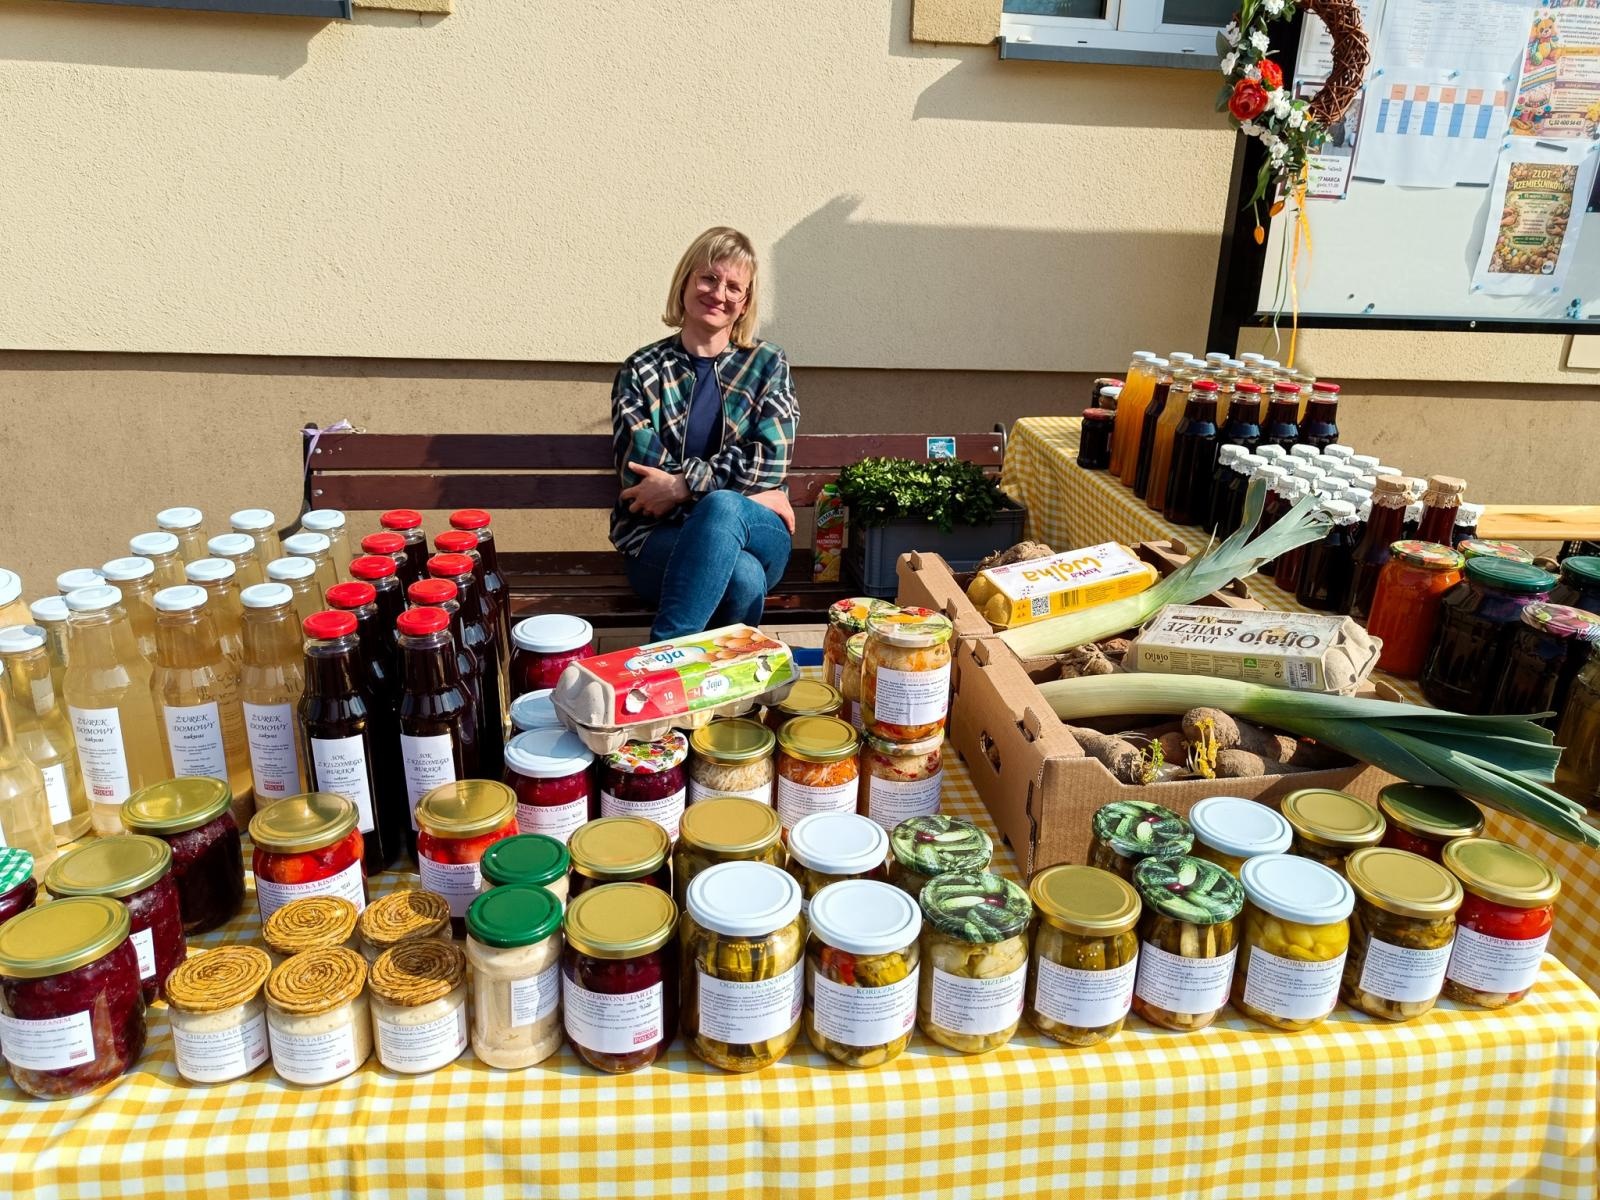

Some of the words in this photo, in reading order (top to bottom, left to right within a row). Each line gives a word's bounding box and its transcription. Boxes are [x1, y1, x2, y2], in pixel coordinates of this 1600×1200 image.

[1021, 556, 1104, 582] wolna
[1184, 634, 1218, 644] JAJA
[663, 691, 674, 700] 10
[174, 721, 216, 732] DOMOWY
[250, 722, 288, 732] DOMOWY
[519, 804, 550, 813] KISZONA
[1479, 934, 1515, 946] PAPRYKA
